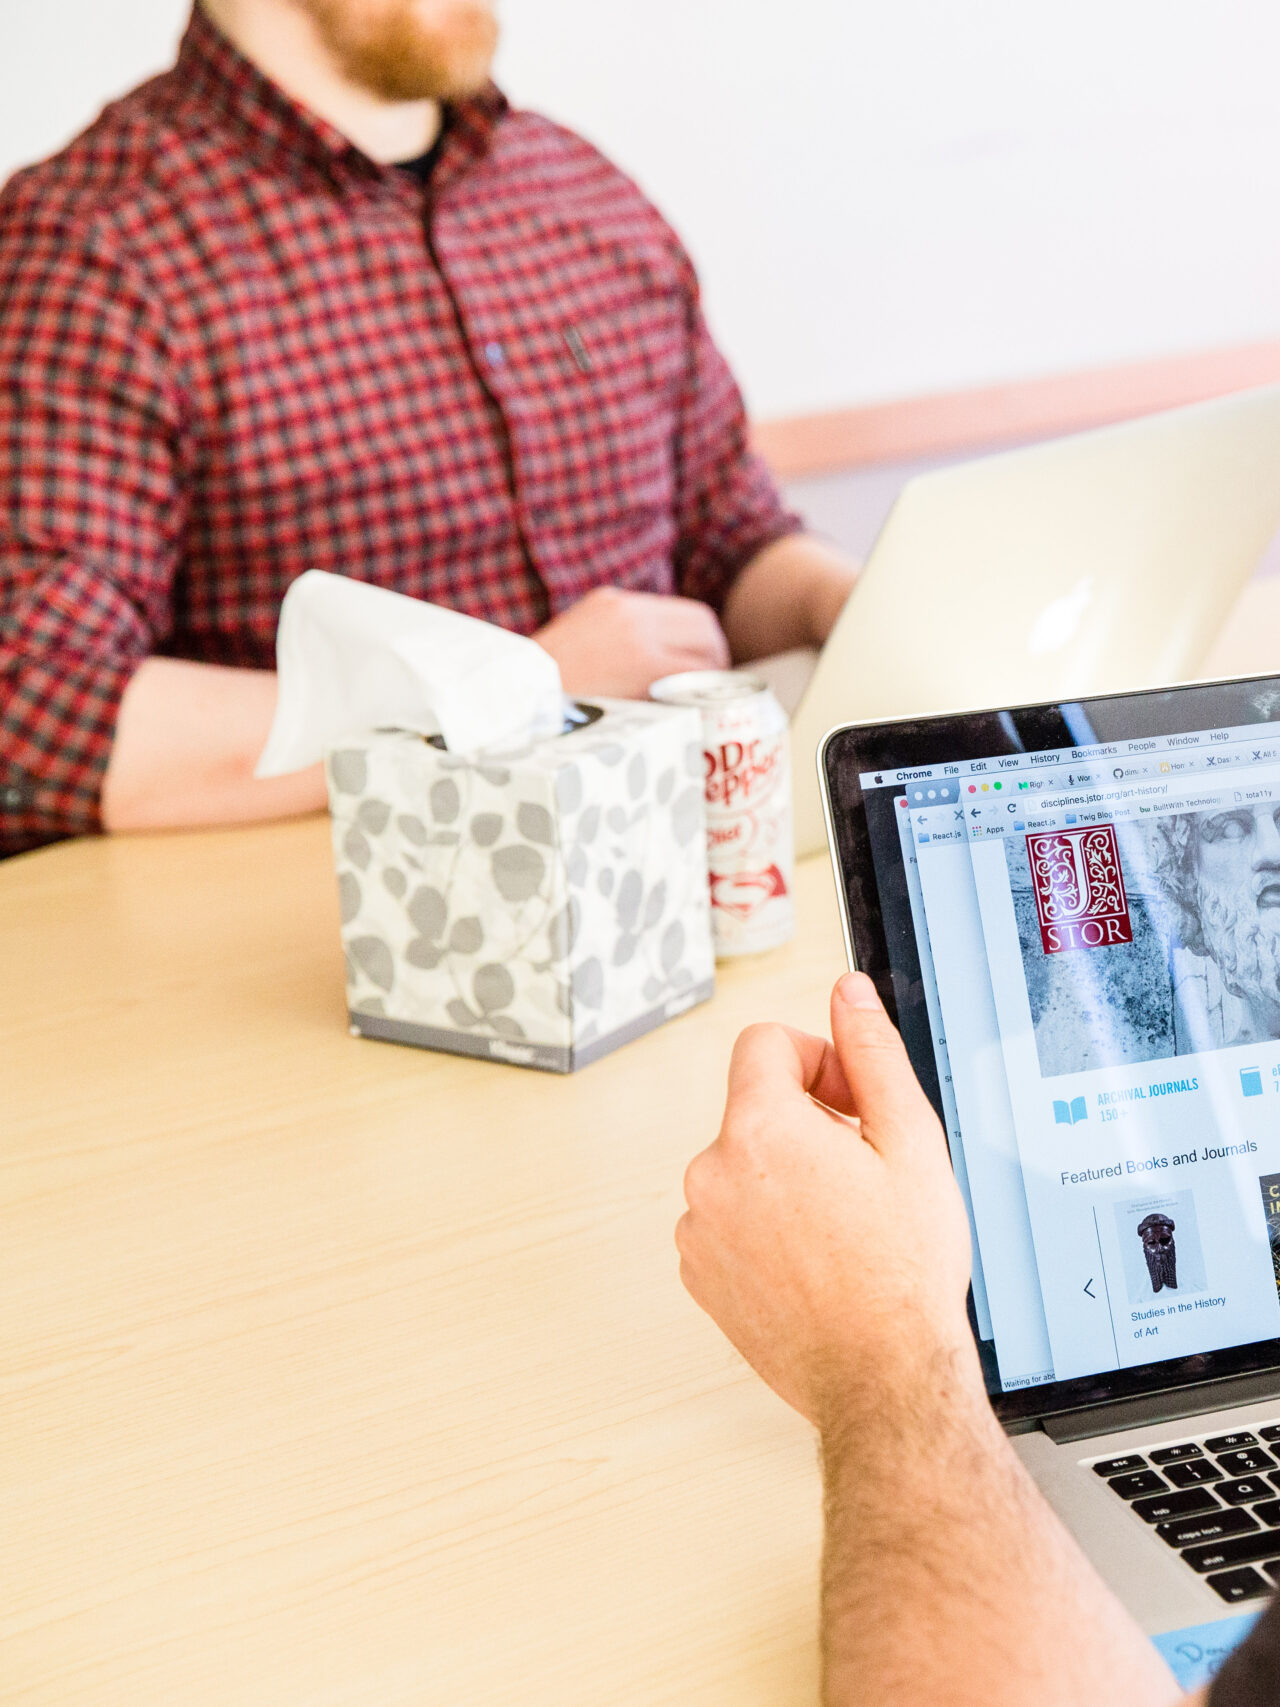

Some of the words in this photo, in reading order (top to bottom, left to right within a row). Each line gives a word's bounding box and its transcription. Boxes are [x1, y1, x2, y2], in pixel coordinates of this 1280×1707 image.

[896, 769, 932, 781] Chrome
[944, 766, 960, 775] File
[970, 763, 987, 772] Edit
[998, 759, 1019, 768] View
[1030, 754, 1060, 764] History
[1072, 746, 1118, 759] Bookmarks
[1128, 741, 1156, 752] People
[1167, 735, 1200, 746] Window
[1210, 732, 1230, 742] Help
[1040, 784, 1168, 808] disciplines.jstor.org/art-history/
[1079, 813, 1096, 823] Twig
[1098, 810, 1113, 820] Blog
[1114, 808, 1131, 817] Post
[986, 824, 1004, 835] Apps
[1028, 818, 1056, 829] React.js
[932, 830, 962, 840] React.js
[1097, 1087, 1146, 1106] ARCHIVAL
[1148, 1077, 1200, 1098] JOURNALS
[1100, 1108, 1118, 1122] 150
[1060, 1163, 1122, 1186] Featured
[1126, 1156, 1168, 1174] Books
[1172, 1150, 1198, 1167] and
[1201, 1140, 1258, 1161] Journals
[1130, 1308, 1166, 1322] Studies
[1168, 1306, 1176, 1316] in
[1178, 1302, 1193, 1314] the
[1195, 1296, 1226, 1311] History
[1133, 1328, 1143, 1340] of
[1145, 1326, 1160, 1336] Art
[1004, 1378, 1030, 1388] Waiting
[1032, 1376, 1042, 1384] for
[1245, 1460, 1257, 1468] 2
[1238, 1484, 1254, 1493] Q
